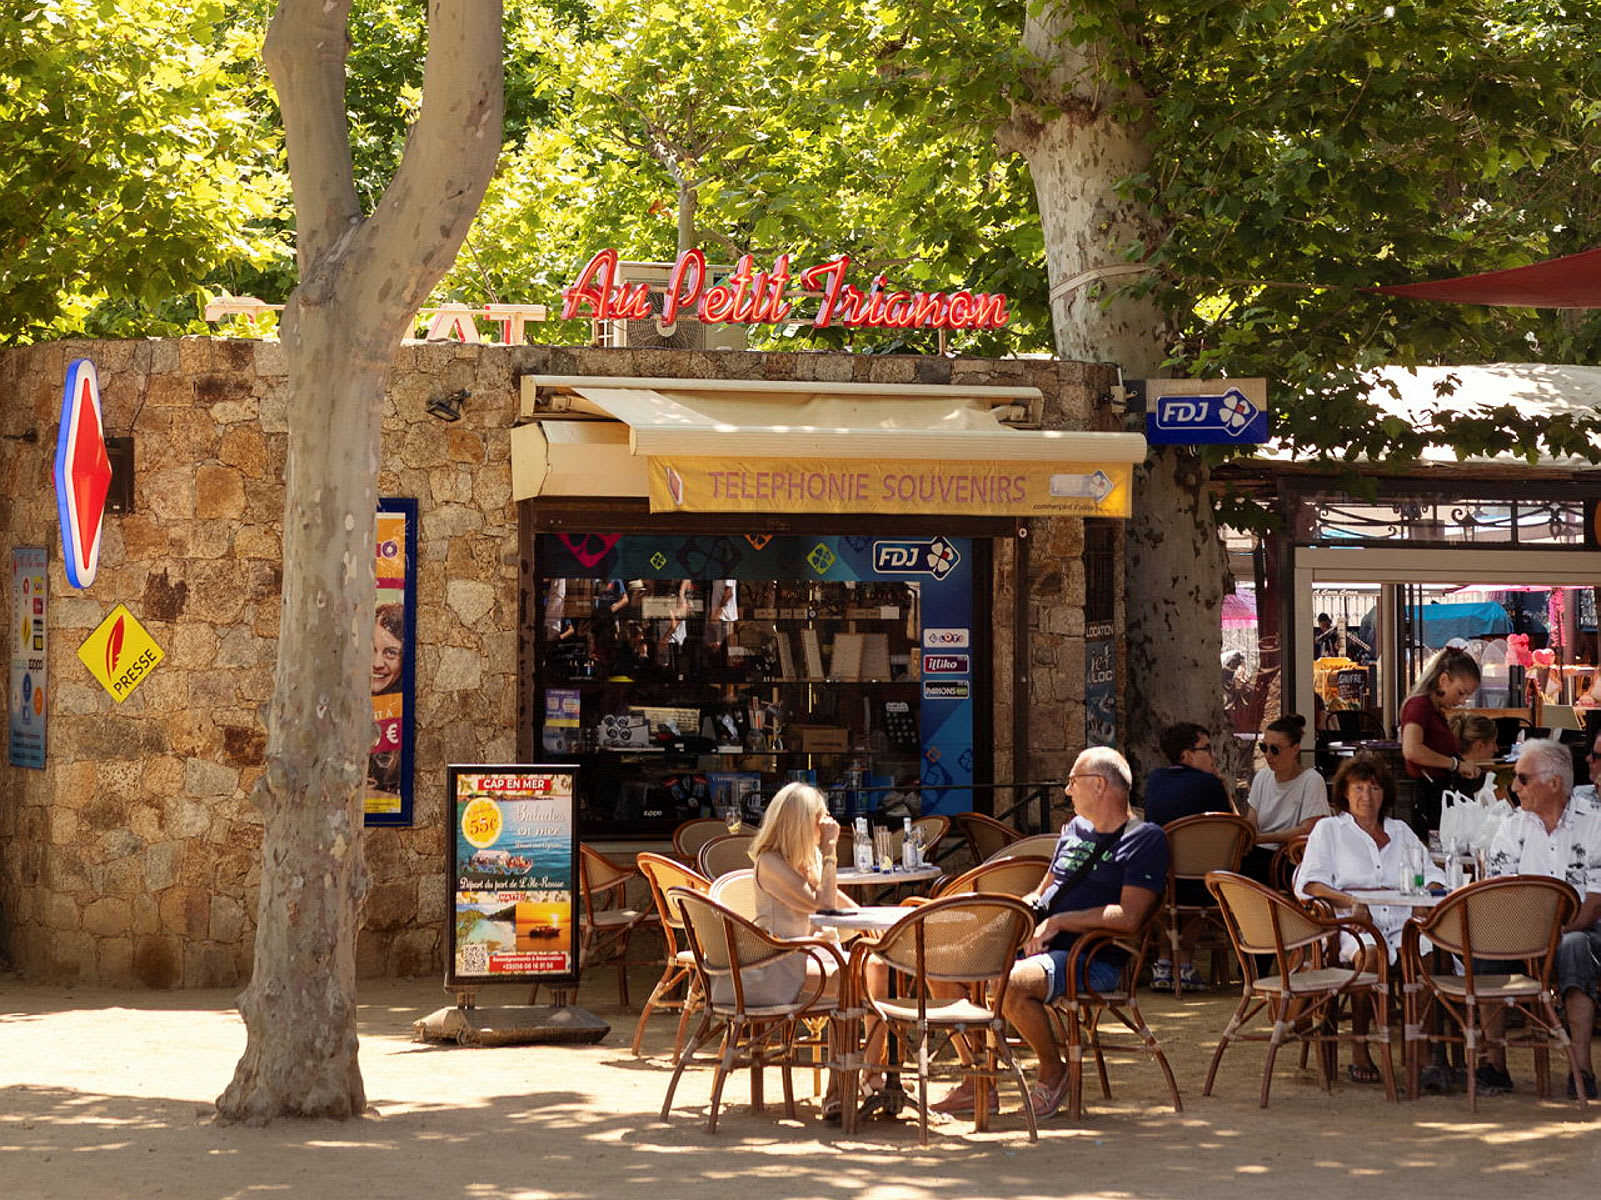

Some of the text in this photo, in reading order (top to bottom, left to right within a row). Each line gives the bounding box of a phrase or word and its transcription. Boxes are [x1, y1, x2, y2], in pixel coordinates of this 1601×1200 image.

[561, 248, 1010, 328] Au Petit Trianon
[1163, 402, 1209, 422] FDJ
[708, 471, 1026, 503] TELEPHONIE SOUVENIRS
[879, 547, 919, 567] FDJ
[113, 648, 157, 696] PRESSE
[483, 779, 545, 789] CAP EN MER
